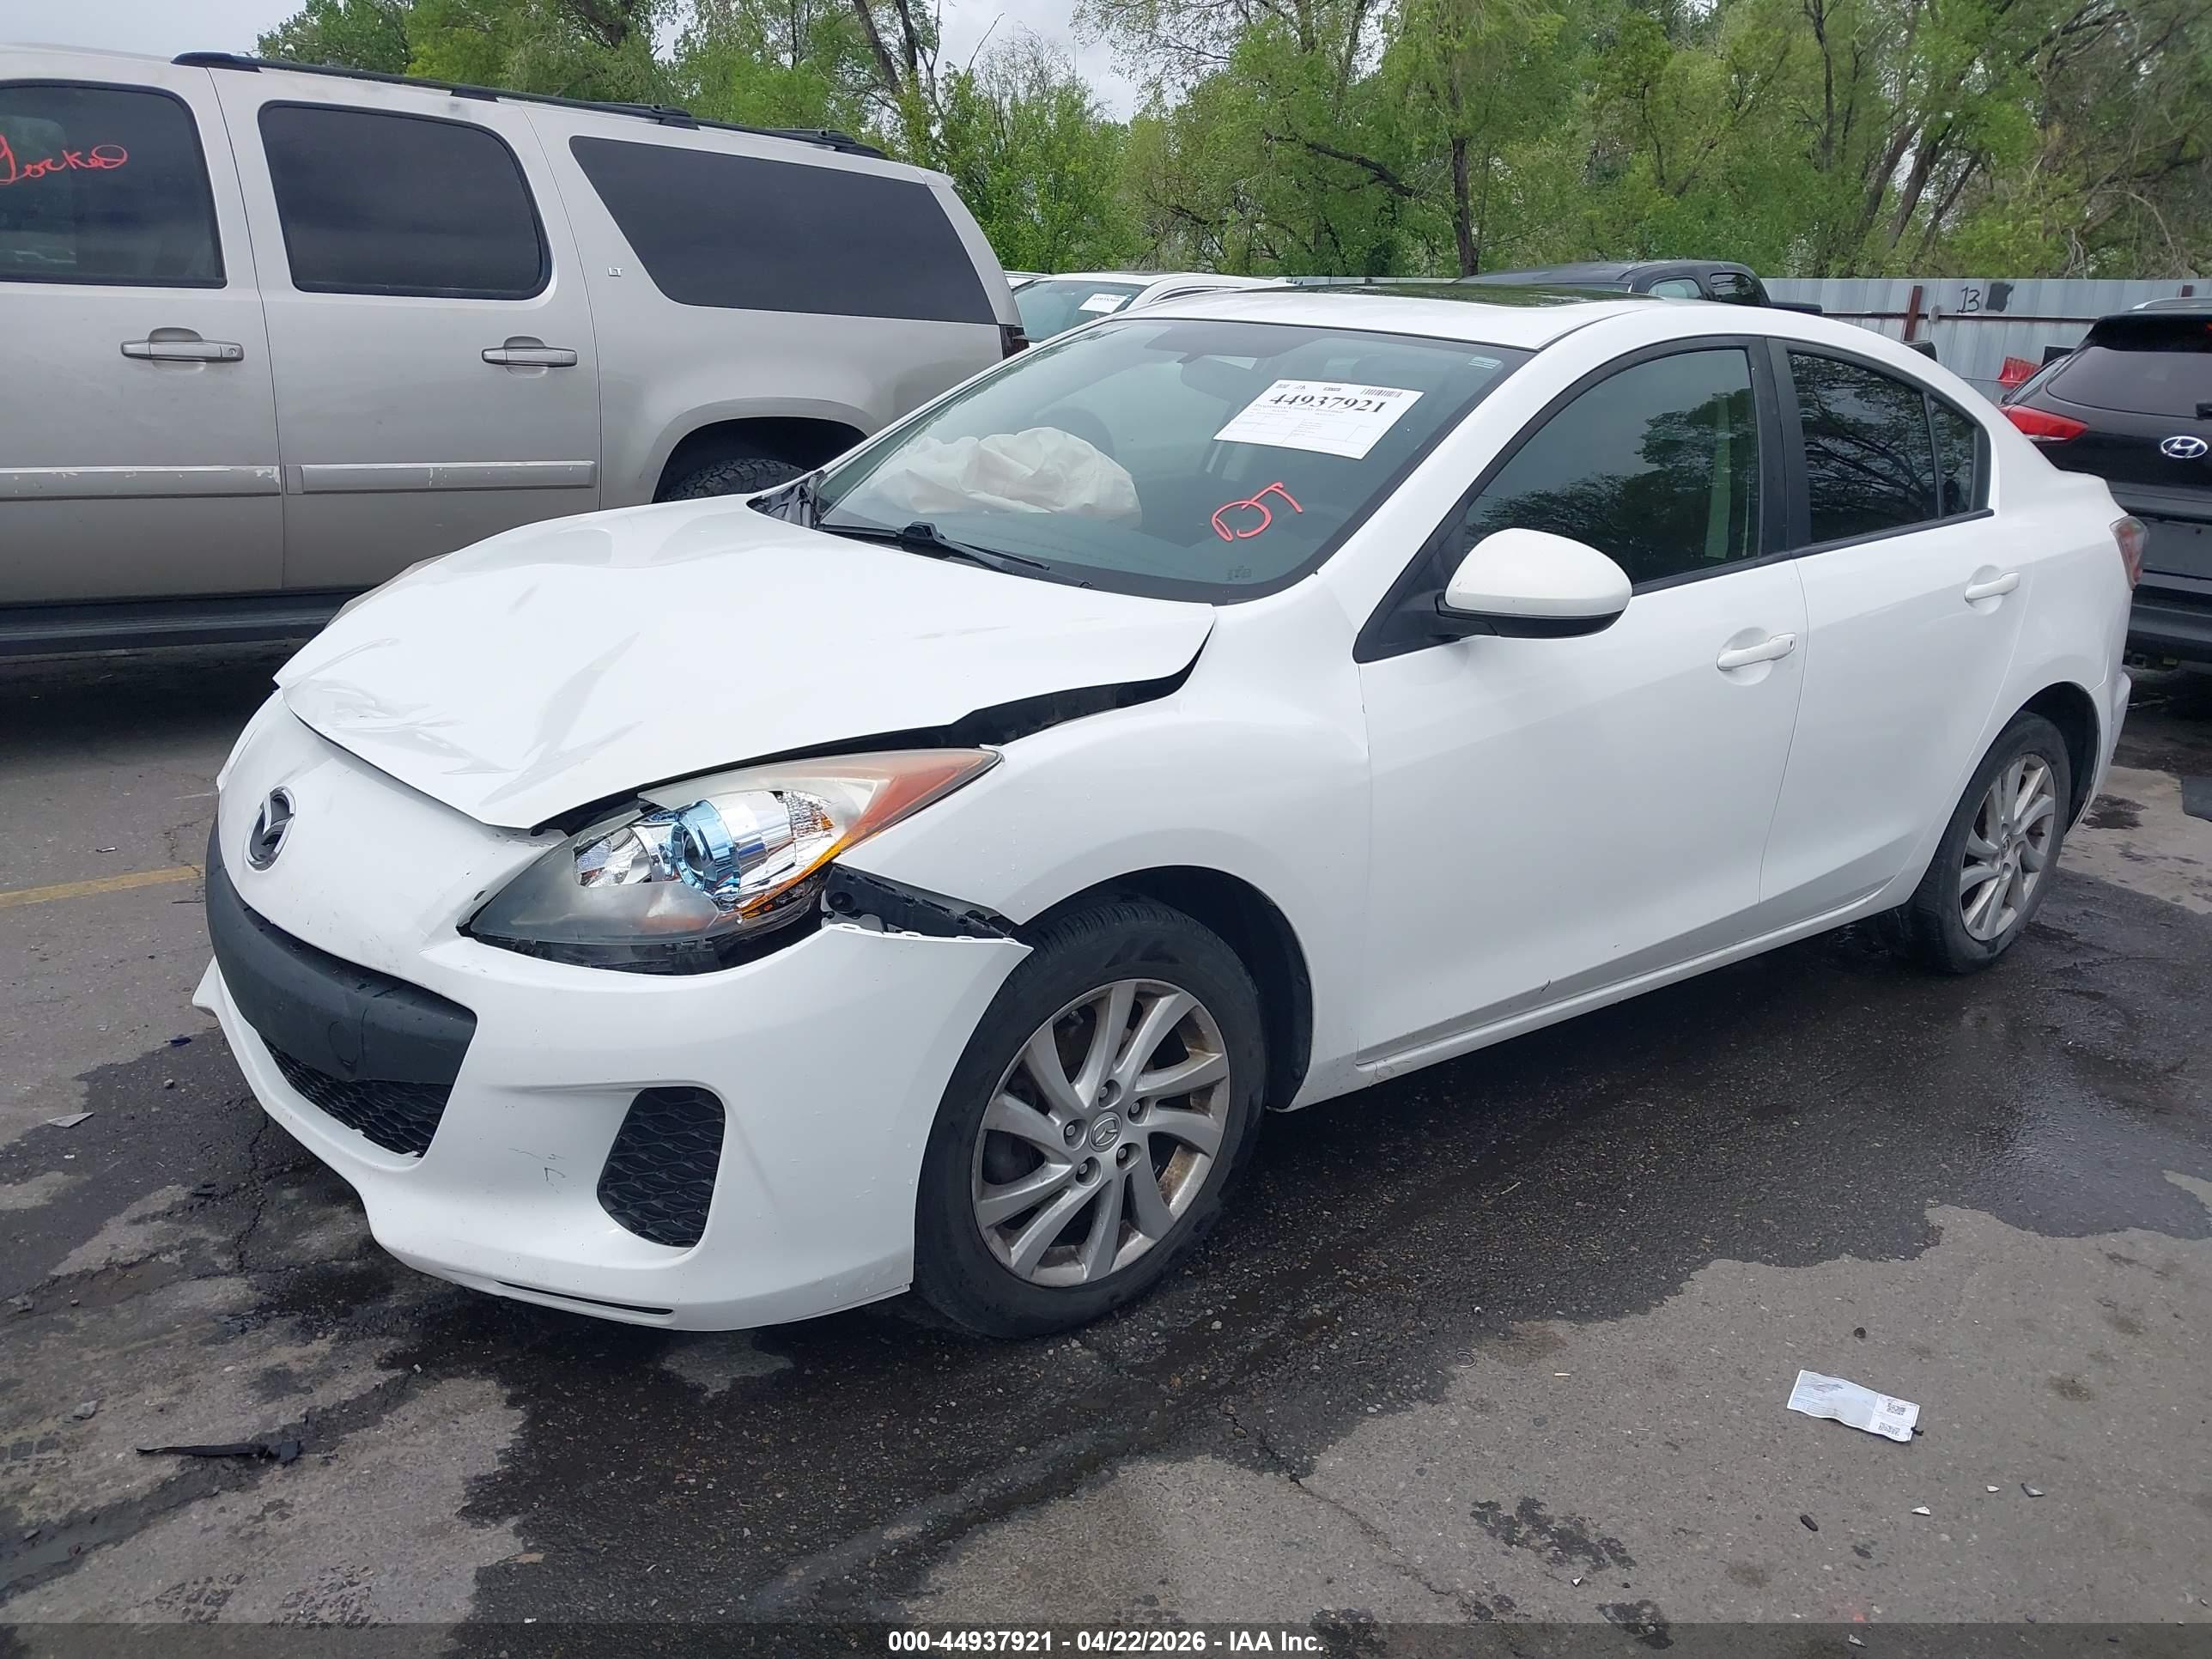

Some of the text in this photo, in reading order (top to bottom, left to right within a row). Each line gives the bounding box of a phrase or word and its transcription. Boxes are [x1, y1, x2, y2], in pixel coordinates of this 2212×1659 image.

[607, 267, 623, 276] LT
[1957, 287, 1980, 313] 13
[1269, 393, 1388, 413] 44937921
